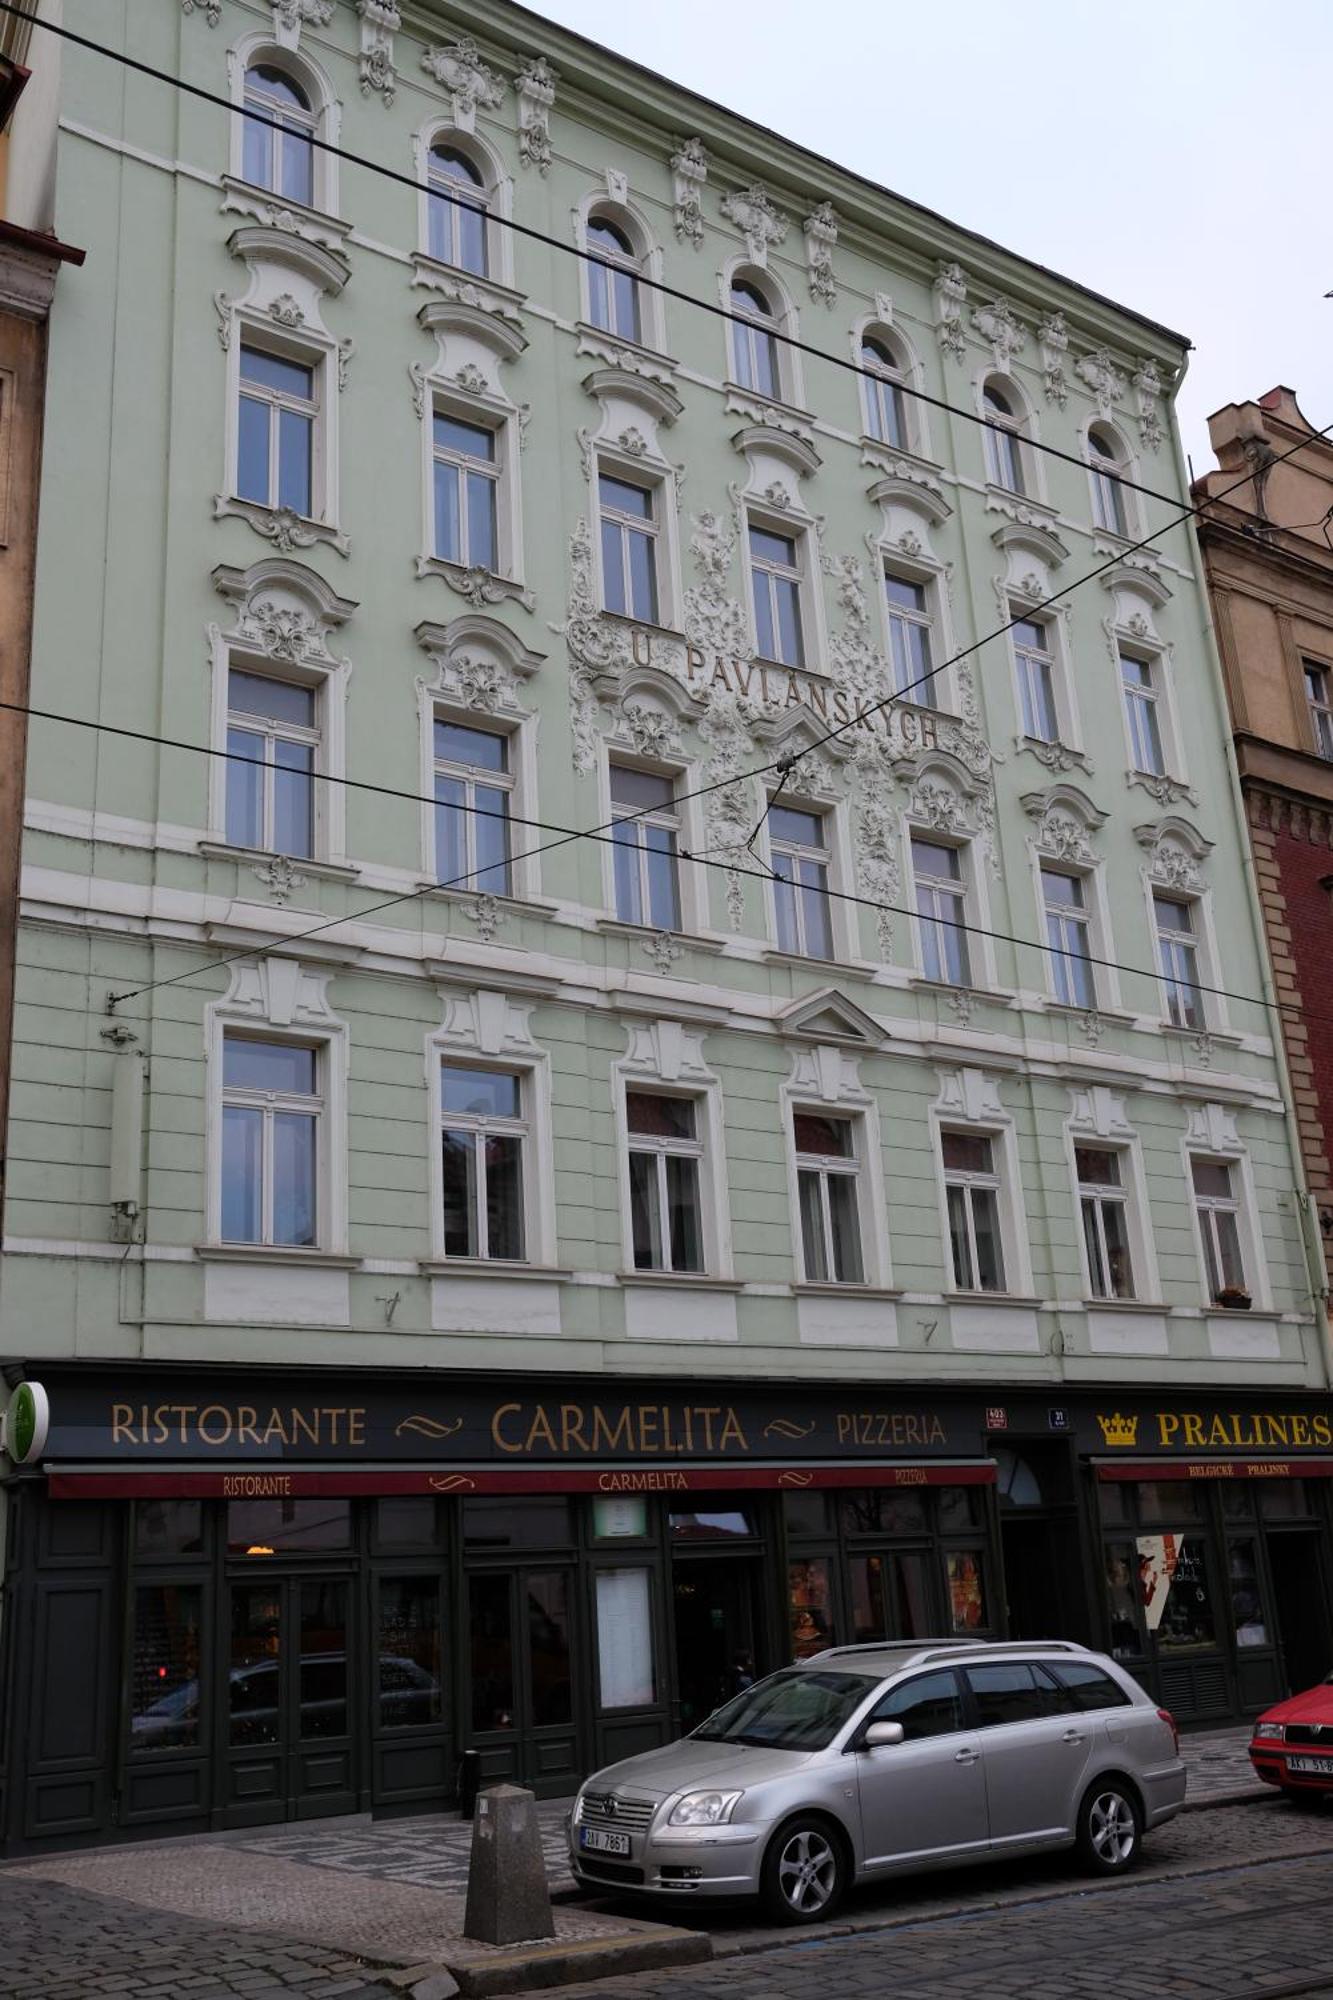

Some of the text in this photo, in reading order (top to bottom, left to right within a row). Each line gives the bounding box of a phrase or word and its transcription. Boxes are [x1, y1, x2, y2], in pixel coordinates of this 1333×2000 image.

[630, 630, 652, 666] U
[111, 1403, 366, 1446] RISTORANTE
[491, 1403, 750, 1453] CARMELITA
[836, 1413, 948, 1446] PIZZERIA
[1155, 1413, 1332, 1446] PRALINES
[223, 1475, 291, 1496] RISTORANTE
[599, 1471, 689, 1491] CARMELITA
[895, 1468, 928, 1485] PIZZERIA
